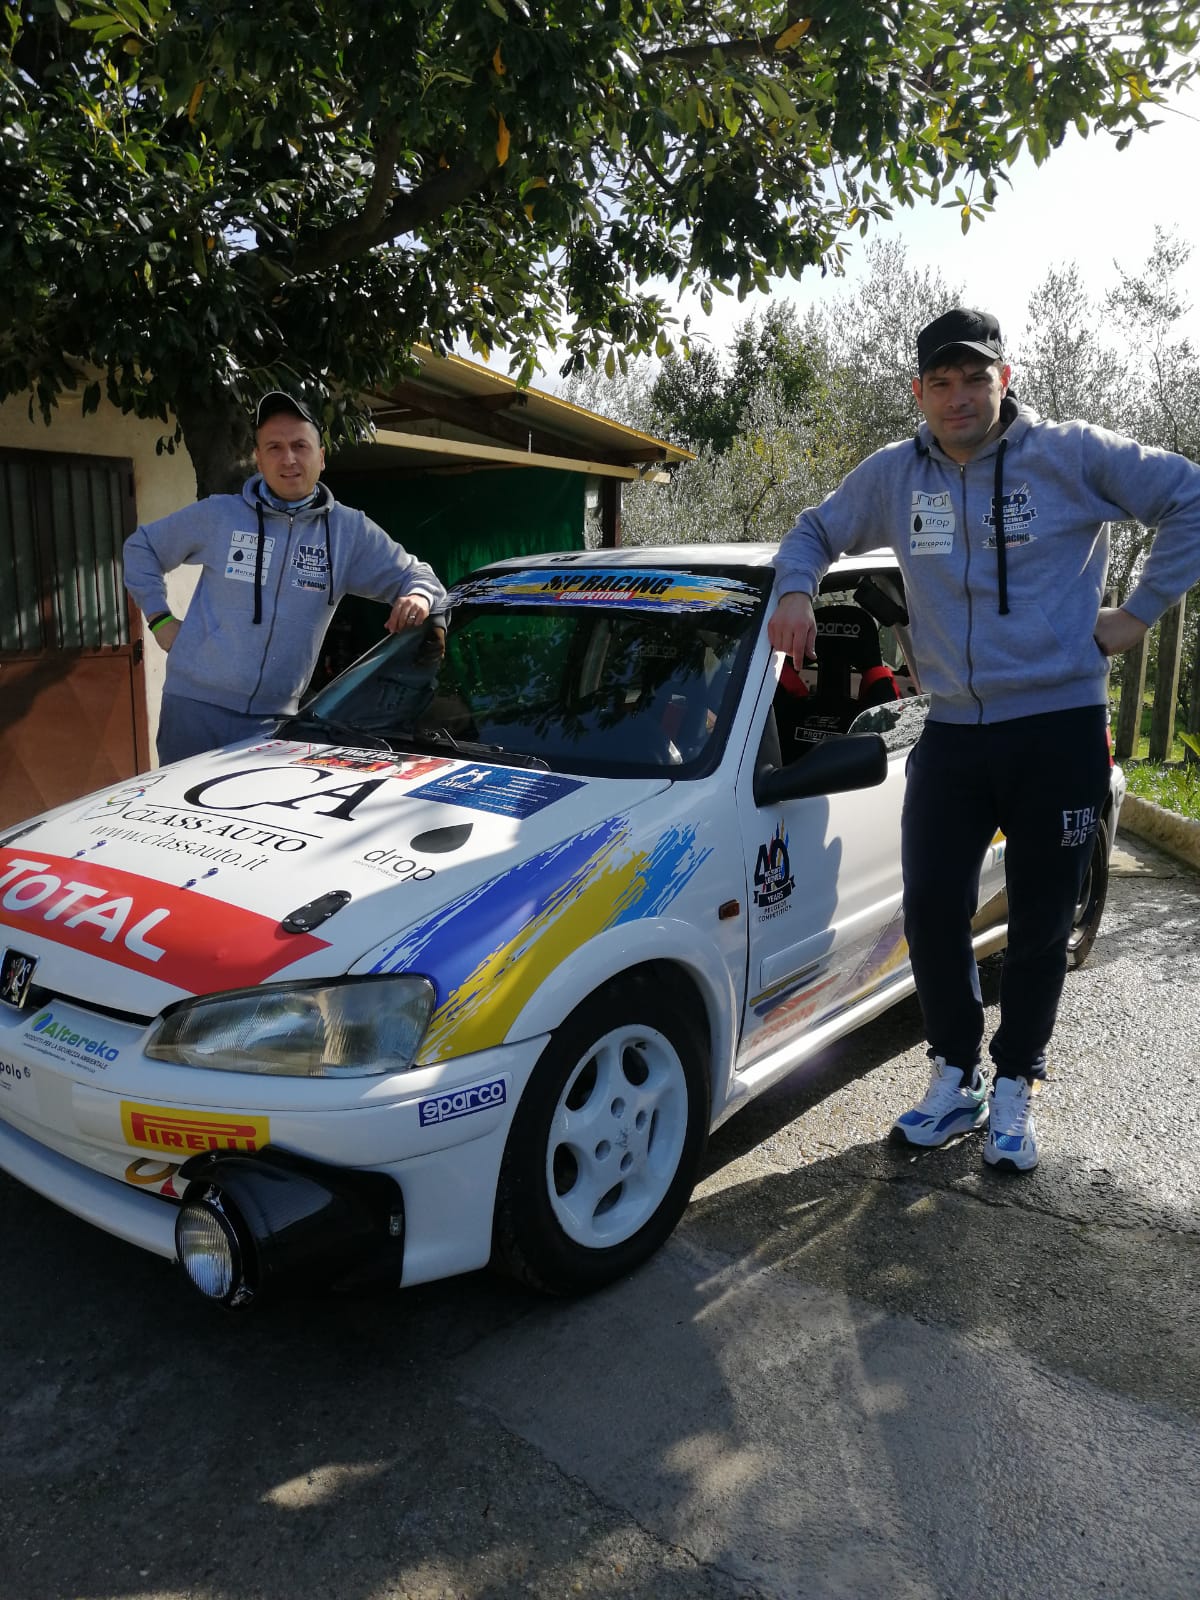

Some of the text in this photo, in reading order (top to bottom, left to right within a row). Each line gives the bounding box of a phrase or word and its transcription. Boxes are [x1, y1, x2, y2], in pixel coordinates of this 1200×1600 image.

[558, 591, 633, 600] COMPETITION
[183, 765, 389, 821] CA
[121, 809, 308, 852] CLASS AUTO
[1062, 806, 1097, 830] FTBL
[1070, 826, 1088, 847] 26
[89, 825, 270, 872] www.classauto.it
[363, 848, 436, 882] drop
[0, 858, 171, 962] TOTAL
[767, 890, 784, 904] YEARS
[40, 1021, 120, 1062] Altereko
[422, 1083, 503, 1121] sparco
[130, 1112, 257, 1153] PIRELLI
